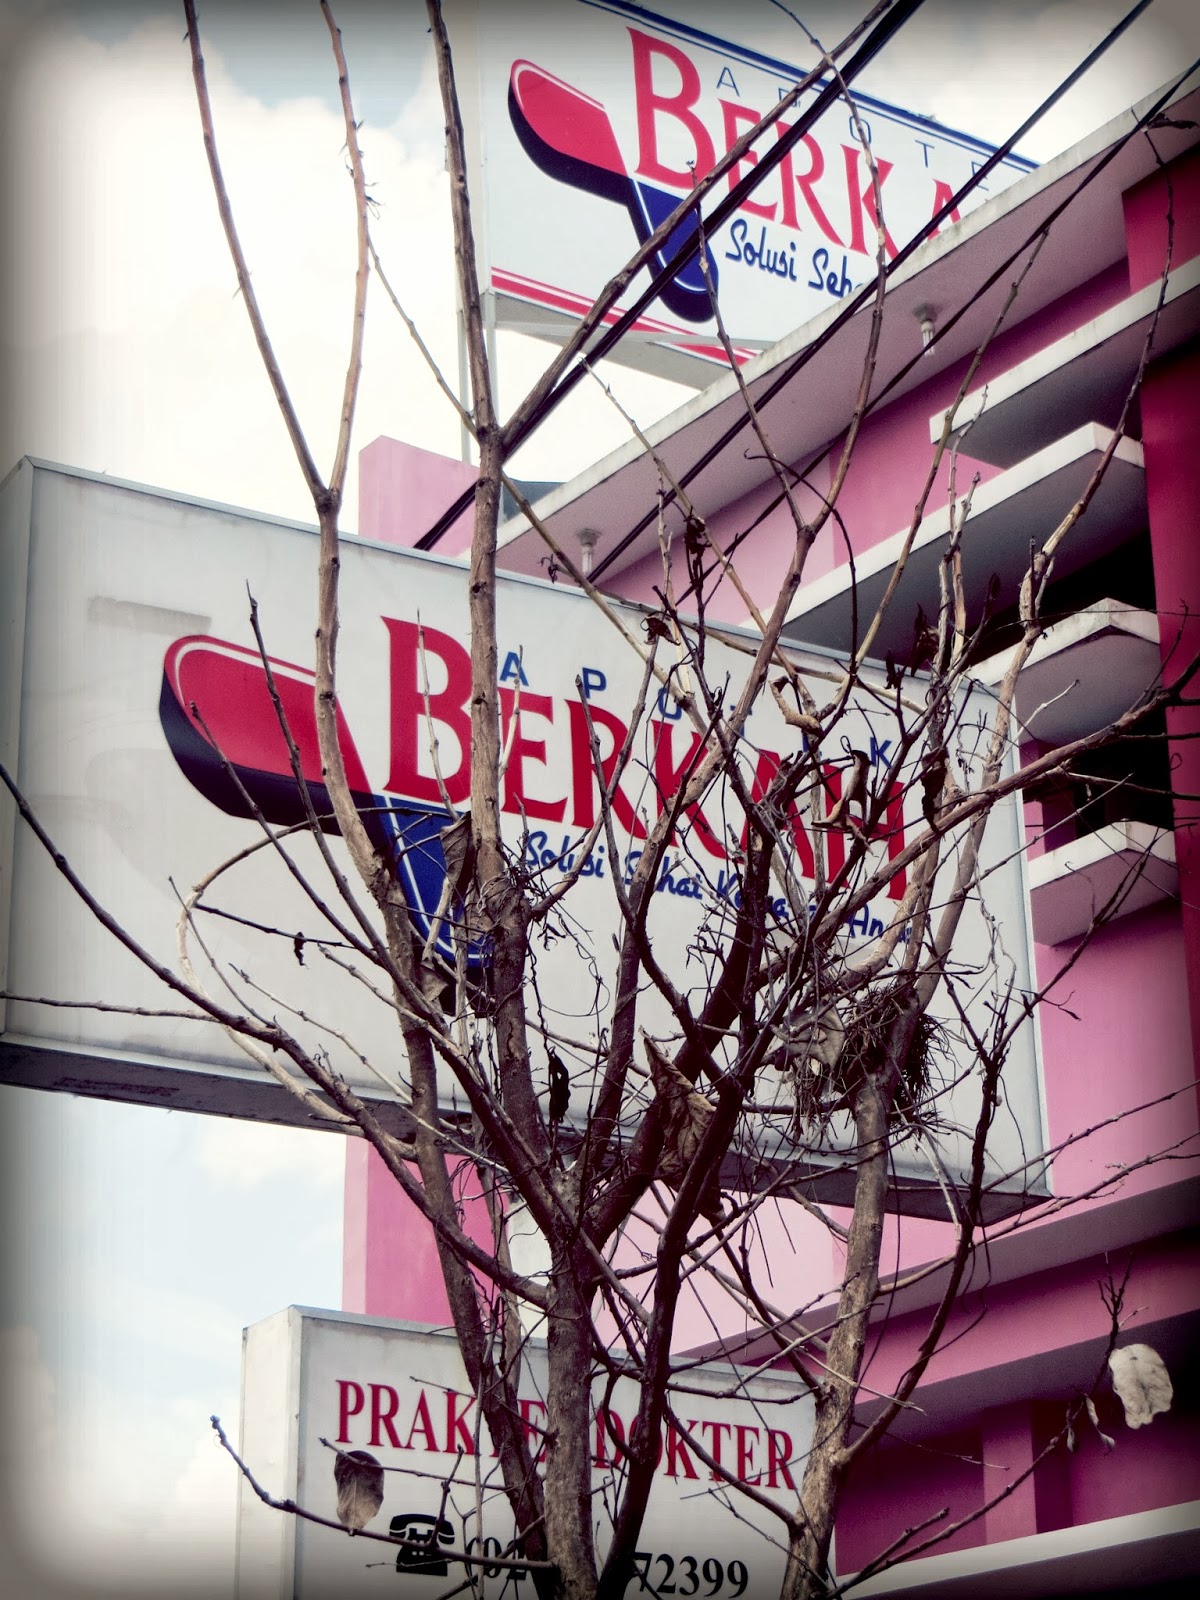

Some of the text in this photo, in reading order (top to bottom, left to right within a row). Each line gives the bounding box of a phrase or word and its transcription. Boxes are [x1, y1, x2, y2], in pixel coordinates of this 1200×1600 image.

[725, 218, 864, 298] Solusi Seh
[526, 830, 605, 879] Solusi
[621, 850, 703, 900] Shat
